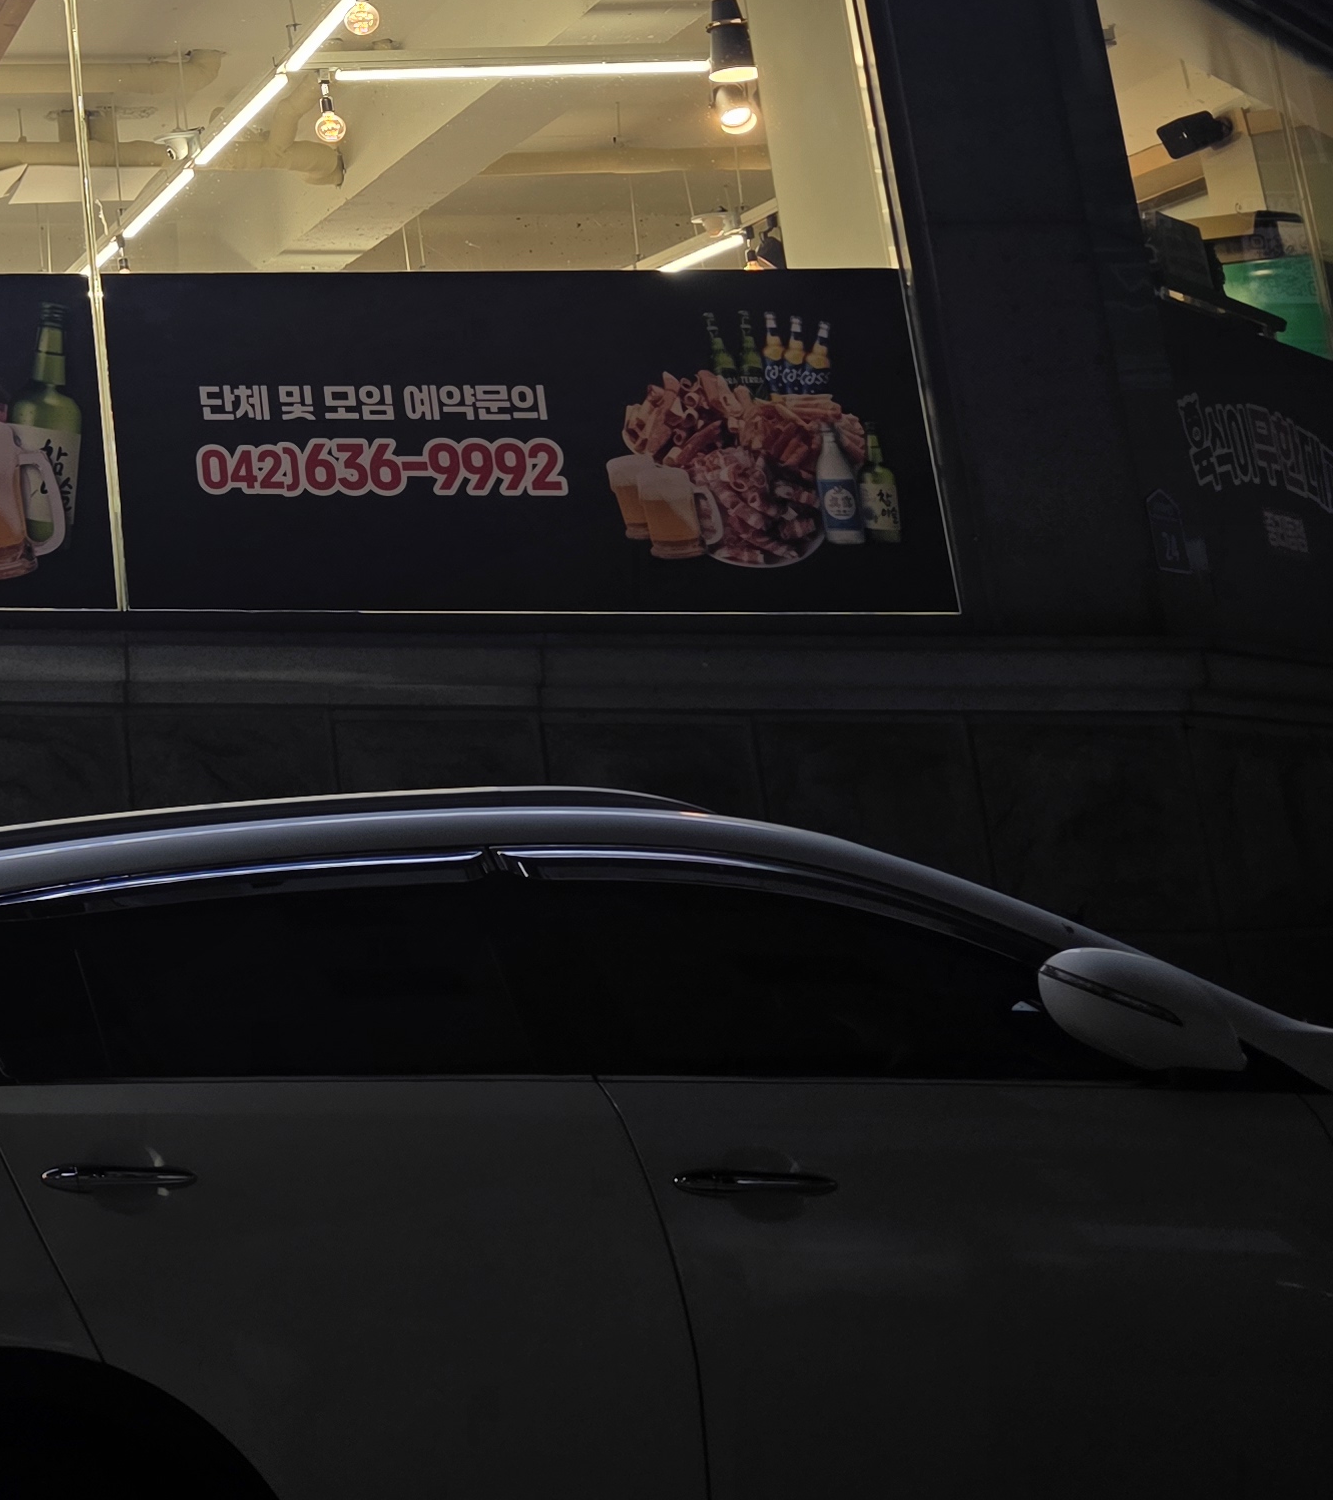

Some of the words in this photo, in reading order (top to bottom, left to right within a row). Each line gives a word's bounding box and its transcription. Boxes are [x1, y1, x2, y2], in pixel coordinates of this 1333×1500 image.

[198, 384, 271, 422] 단체
[279, 384, 315, 422] 및
[324, 384, 394, 421] 모임
[403, 383, 549, 422] 예약문의
[195, 437, 569, 498] 042)636-9992
